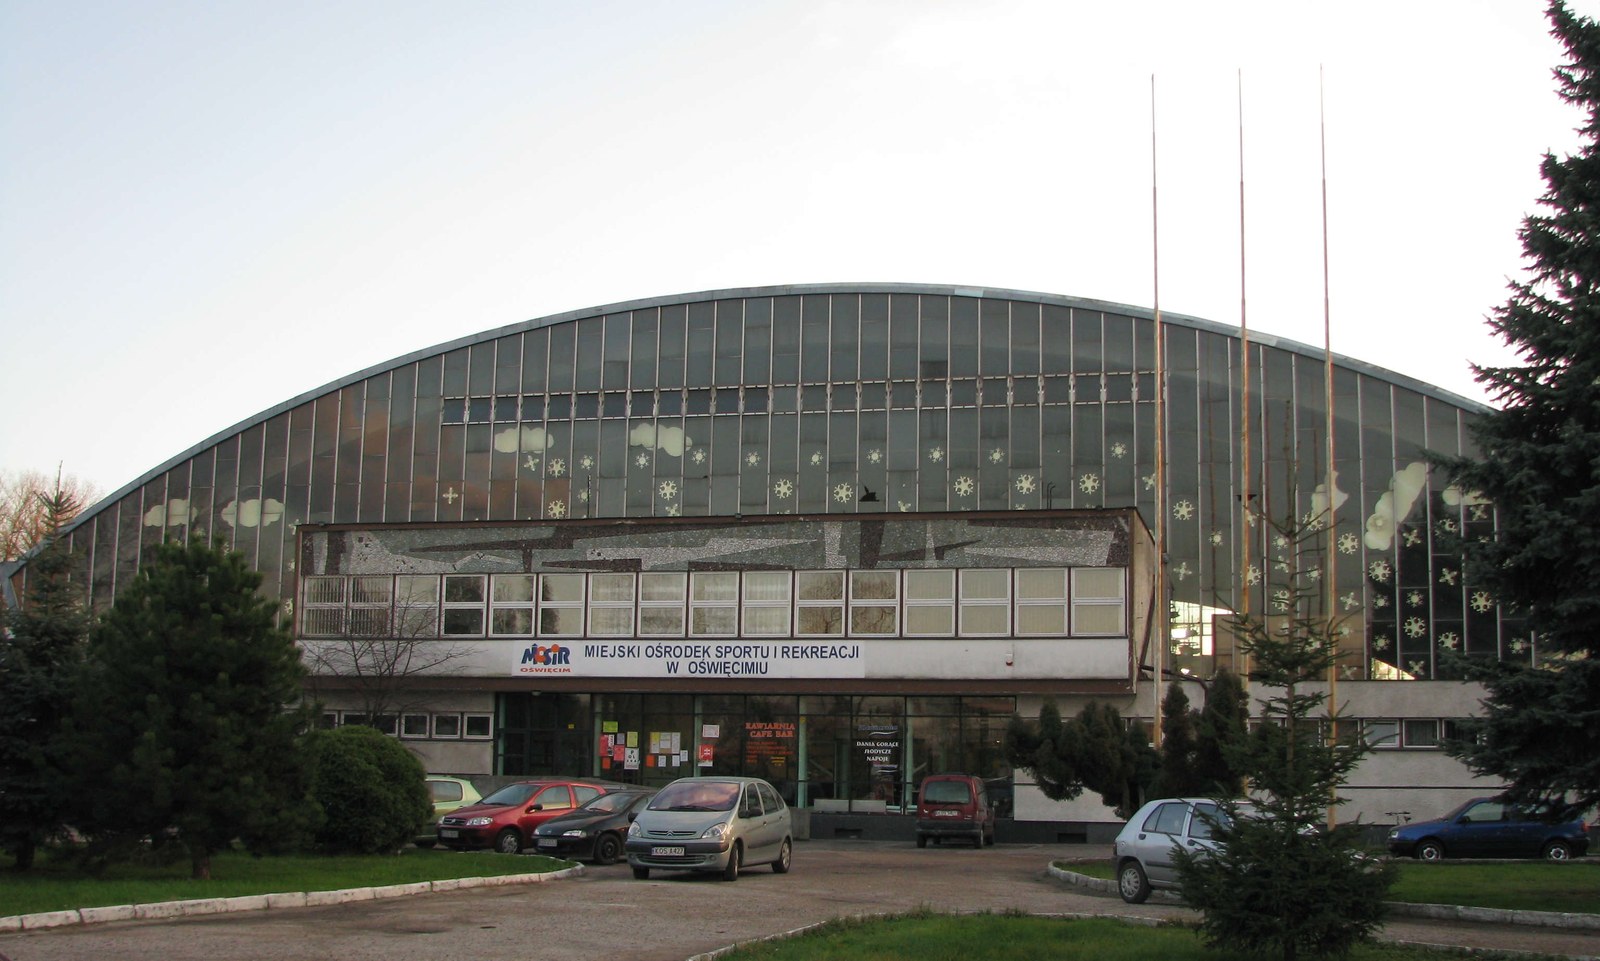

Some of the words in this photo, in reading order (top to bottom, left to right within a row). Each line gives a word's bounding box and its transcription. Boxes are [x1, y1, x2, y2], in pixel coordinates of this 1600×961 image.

[584, 645, 641, 658] MIEJSKI
[645, 643, 711, 658] OŚRODEK
[715, 645, 769, 658] SPORTU
[773, 646, 777, 658] I
[781, 645, 859, 659] REKREACJI
[666, 661, 679, 674] W
[688, 659, 768, 677] OŚWIĘCIMIU
[745, 722, 795, 730] KAWIARNIA
[750, 730, 773, 738] CAFE
[775, 730, 794, 738] BAR
